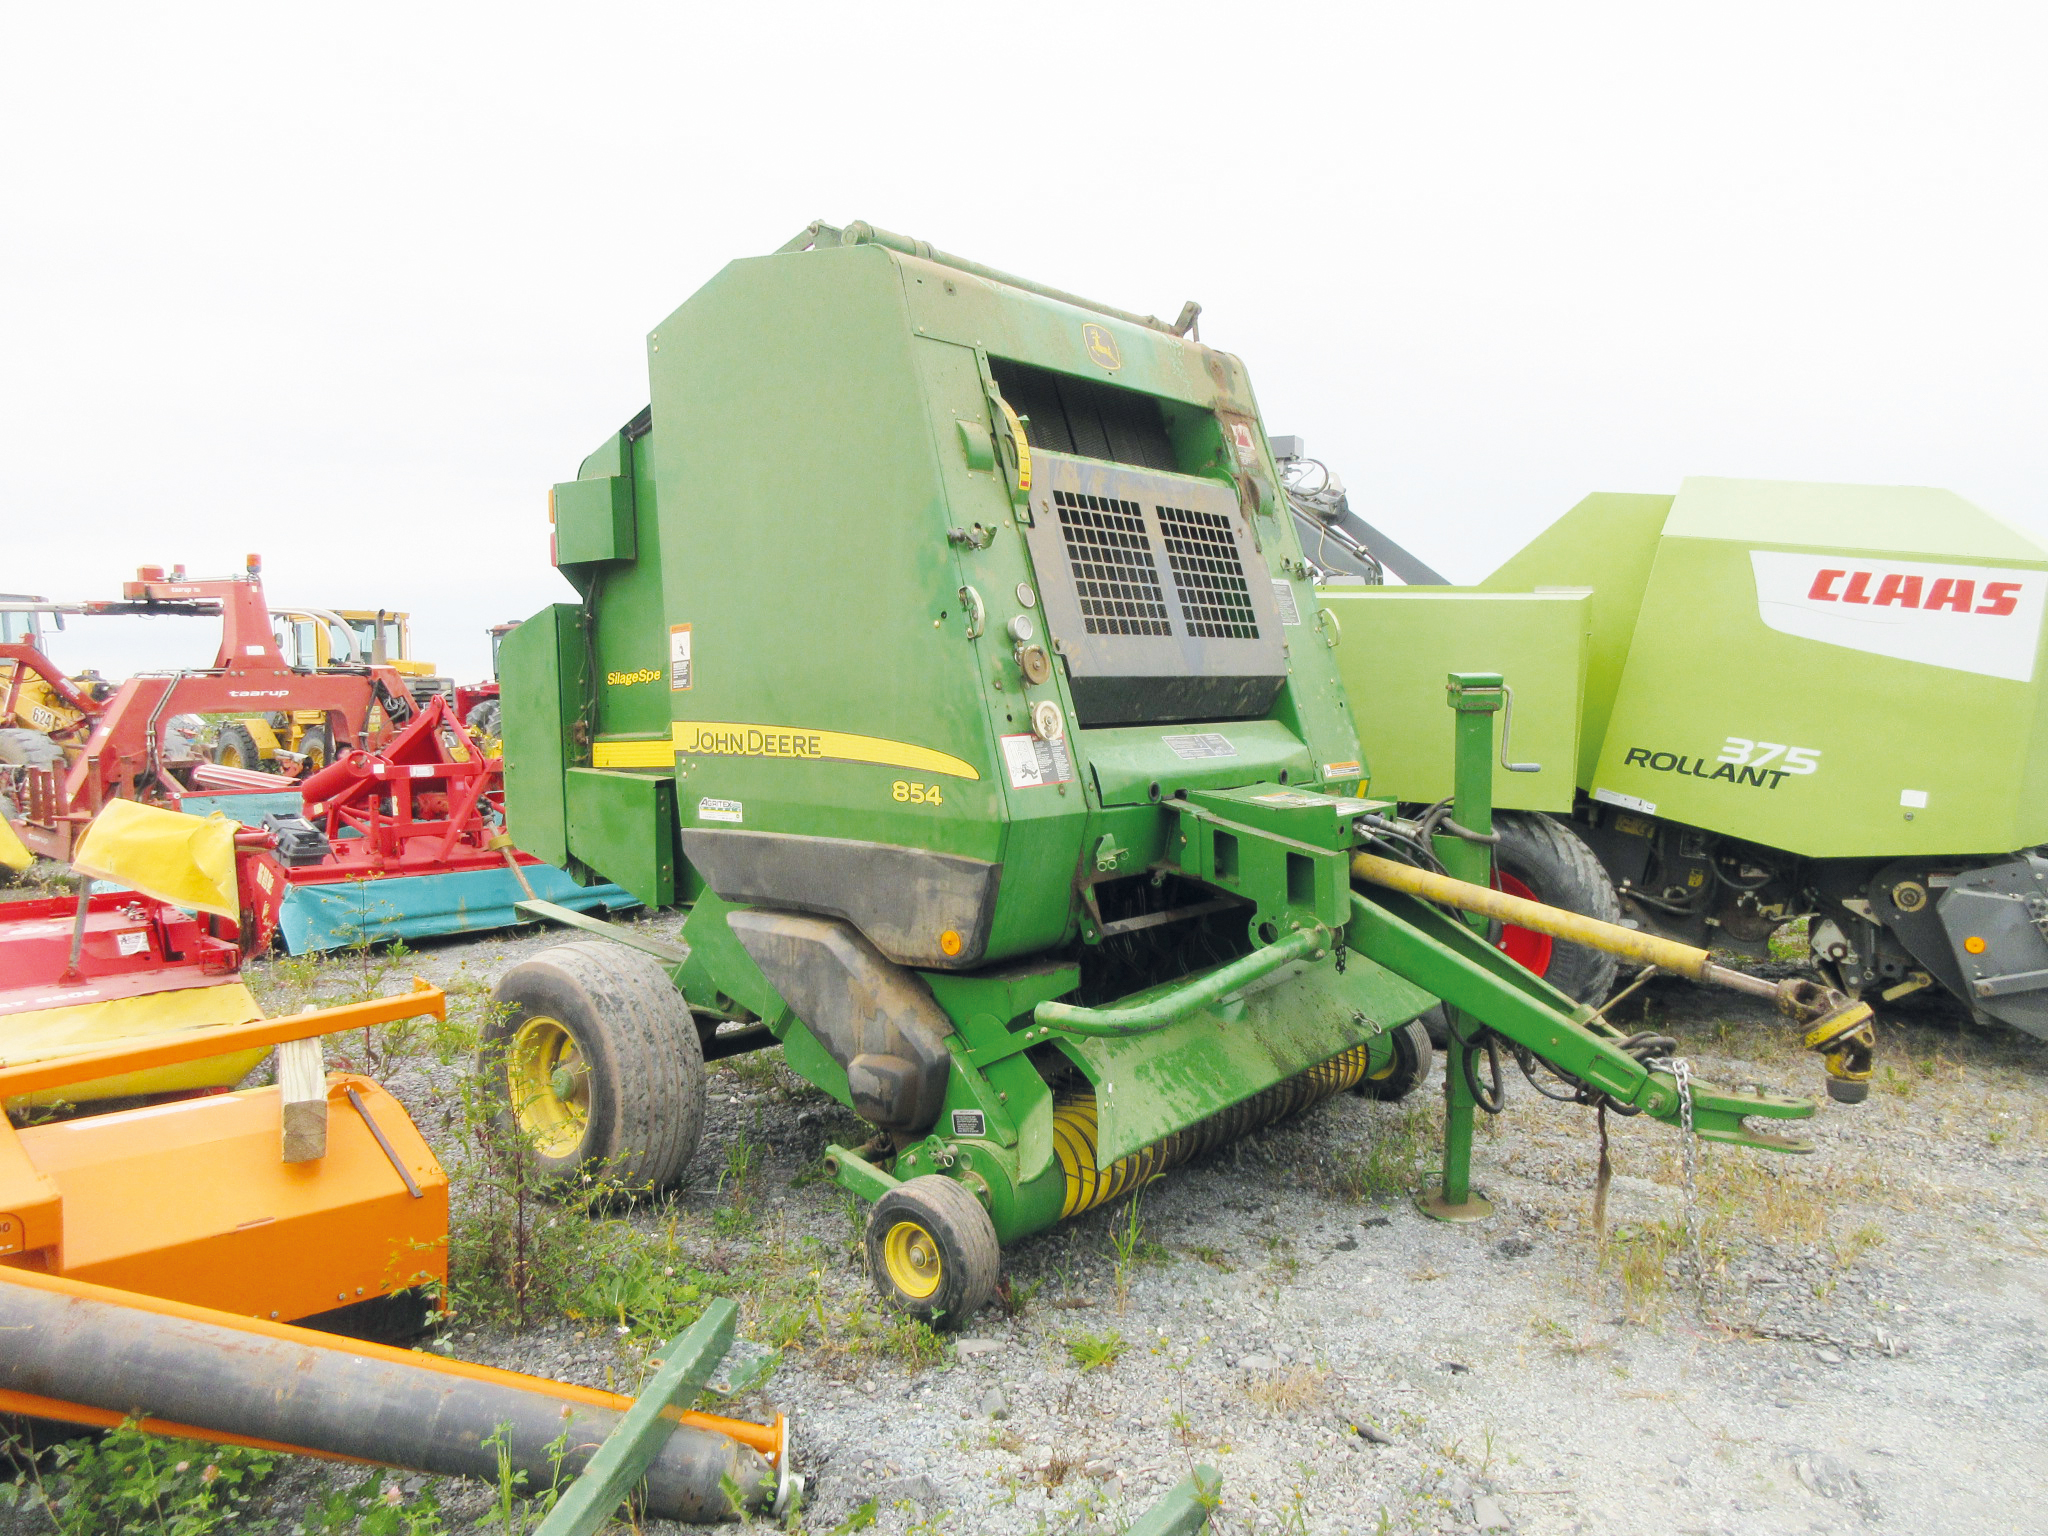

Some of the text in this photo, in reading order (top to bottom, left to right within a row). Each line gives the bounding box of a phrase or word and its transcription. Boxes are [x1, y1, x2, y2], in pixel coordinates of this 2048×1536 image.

[1808, 569, 2023, 616] CLAAS
[607, 668, 662, 686] SilageSpe
[229, 690, 290, 698] taarup
[33, 707, 52, 727] 624
[689, 728, 821, 755] JOHN DEERE
[1624, 747, 1791, 790] ROLLANT
[1717, 736, 1822, 775] 375
[700, 798, 733, 808] AGRITEX
[892, 780, 943, 806] 854
